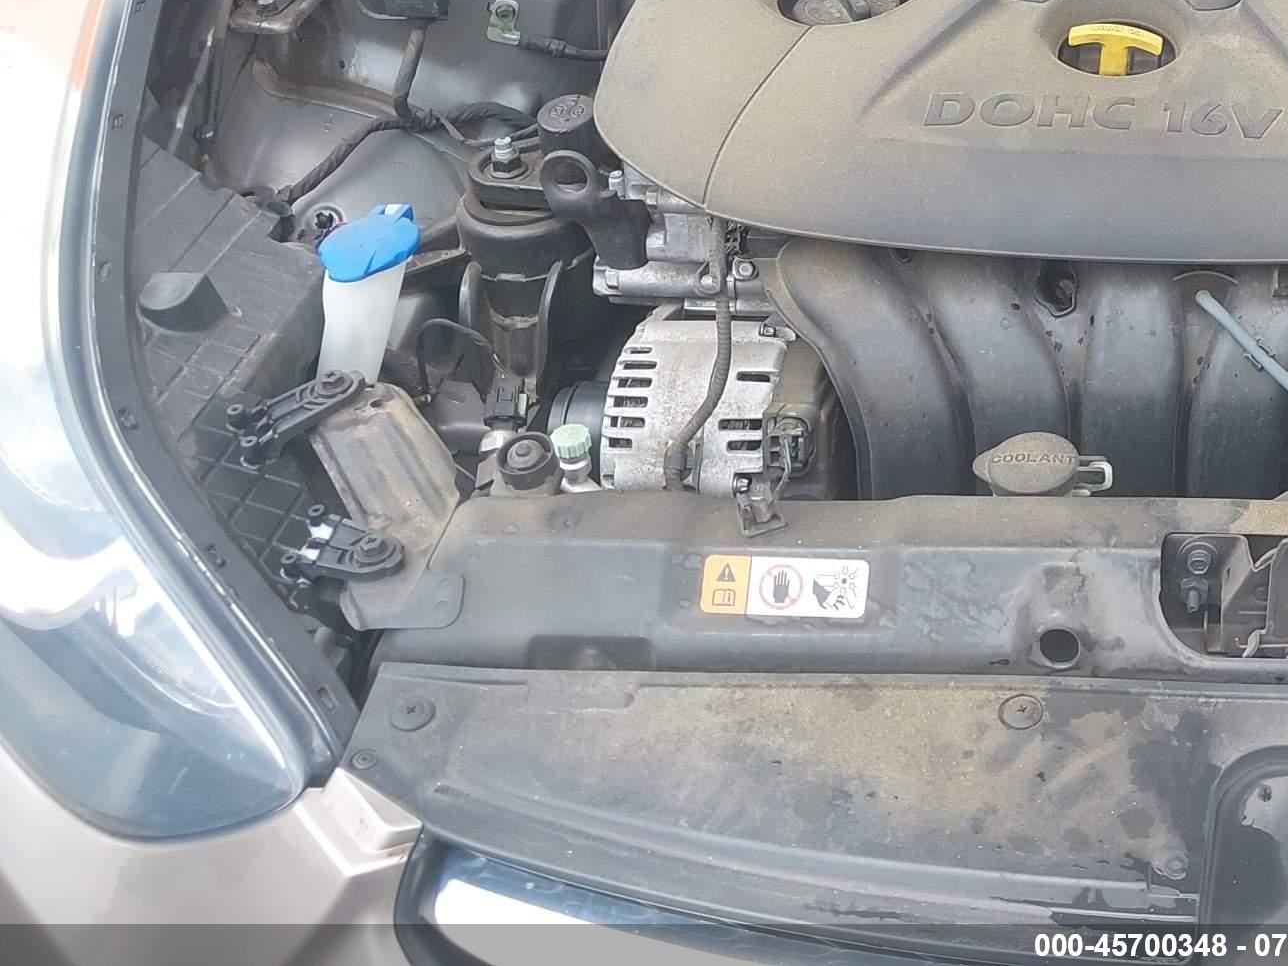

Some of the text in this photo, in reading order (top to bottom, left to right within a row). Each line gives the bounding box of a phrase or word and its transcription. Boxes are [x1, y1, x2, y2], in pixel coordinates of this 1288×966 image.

[923, 92, 1284, 140] DOHC 16V
[991, 453, 1077, 466] COOLANT
